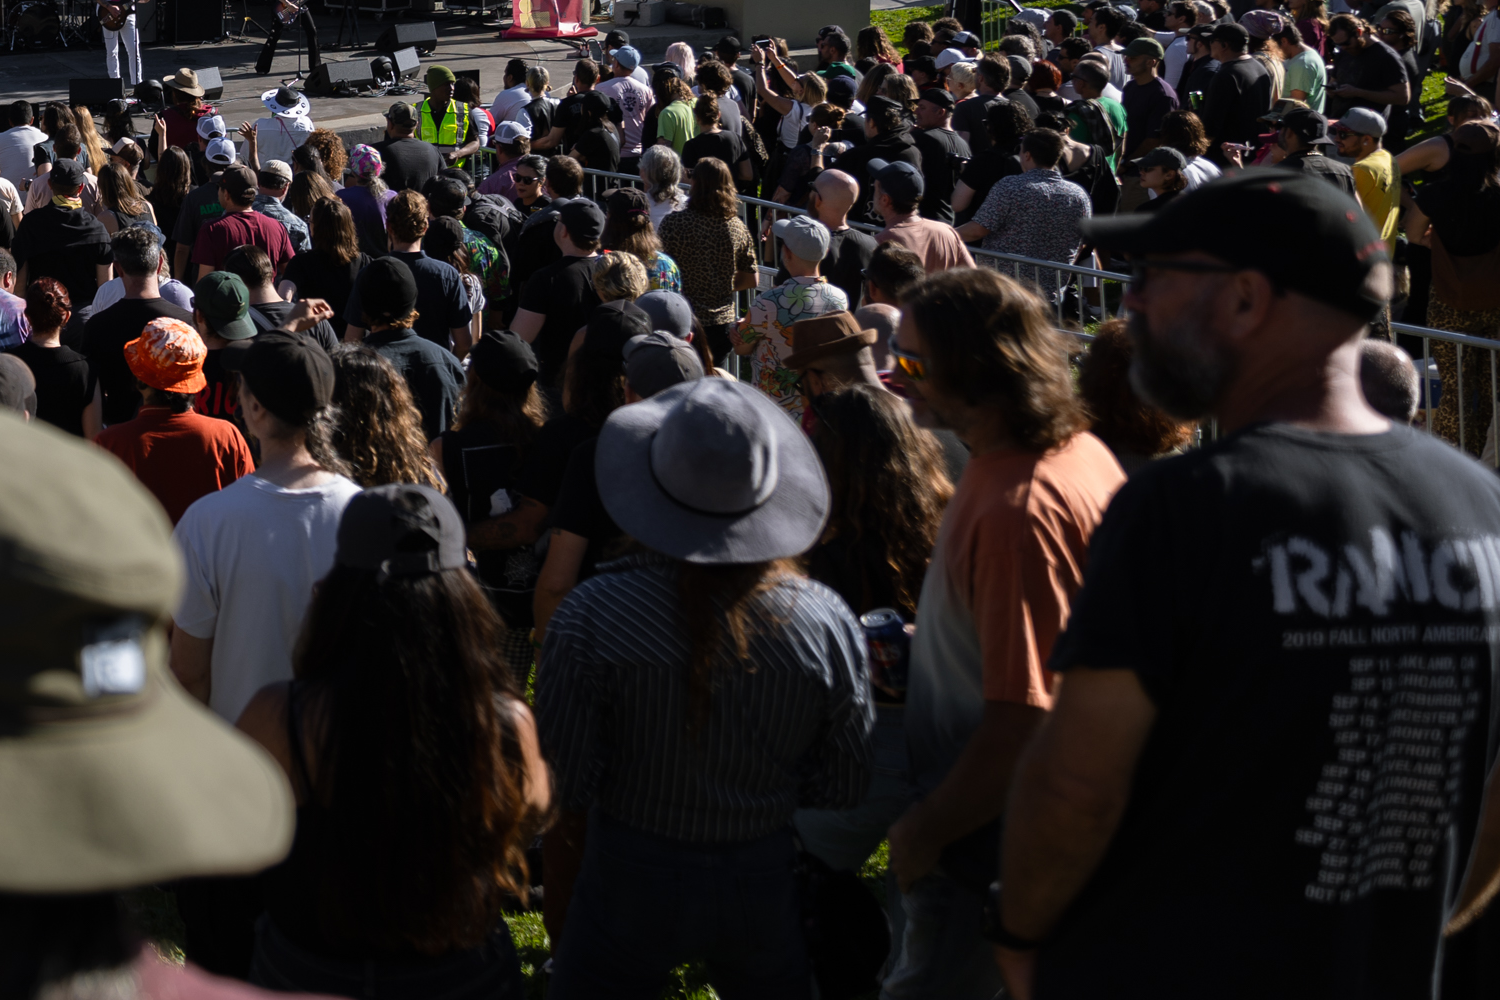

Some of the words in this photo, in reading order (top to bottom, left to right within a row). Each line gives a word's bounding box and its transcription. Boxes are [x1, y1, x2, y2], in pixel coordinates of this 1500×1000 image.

[200, 203, 224, 216] ADD
[1282, 632, 1324, 648] 2019
[1329, 629, 1367, 646] FALL
[1371, 625, 1417, 643] NORTH
[1349, 658, 1374, 672] SEP
[1398, 655, 1456, 671] AKLAND,
[1351, 677, 1376, 691] SEP
[1332, 694, 1358, 709] SEP
[1328, 713, 1354, 727] SEP
[1334, 730, 1359, 744] SEP
[1338, 747, 1366, 762] SEP
[1321, 764, 1349, 778] SEP
[1317, 780, 1344, 795] SEP
[1305, 797, 1333, 812] SEP
[1314, 814, 1343, 831] SEP
[1295, 829, 1324, 845] SEP
[1321, 852, 1349, 868] SEP
[1318, 869, 1346, 885] SEP
